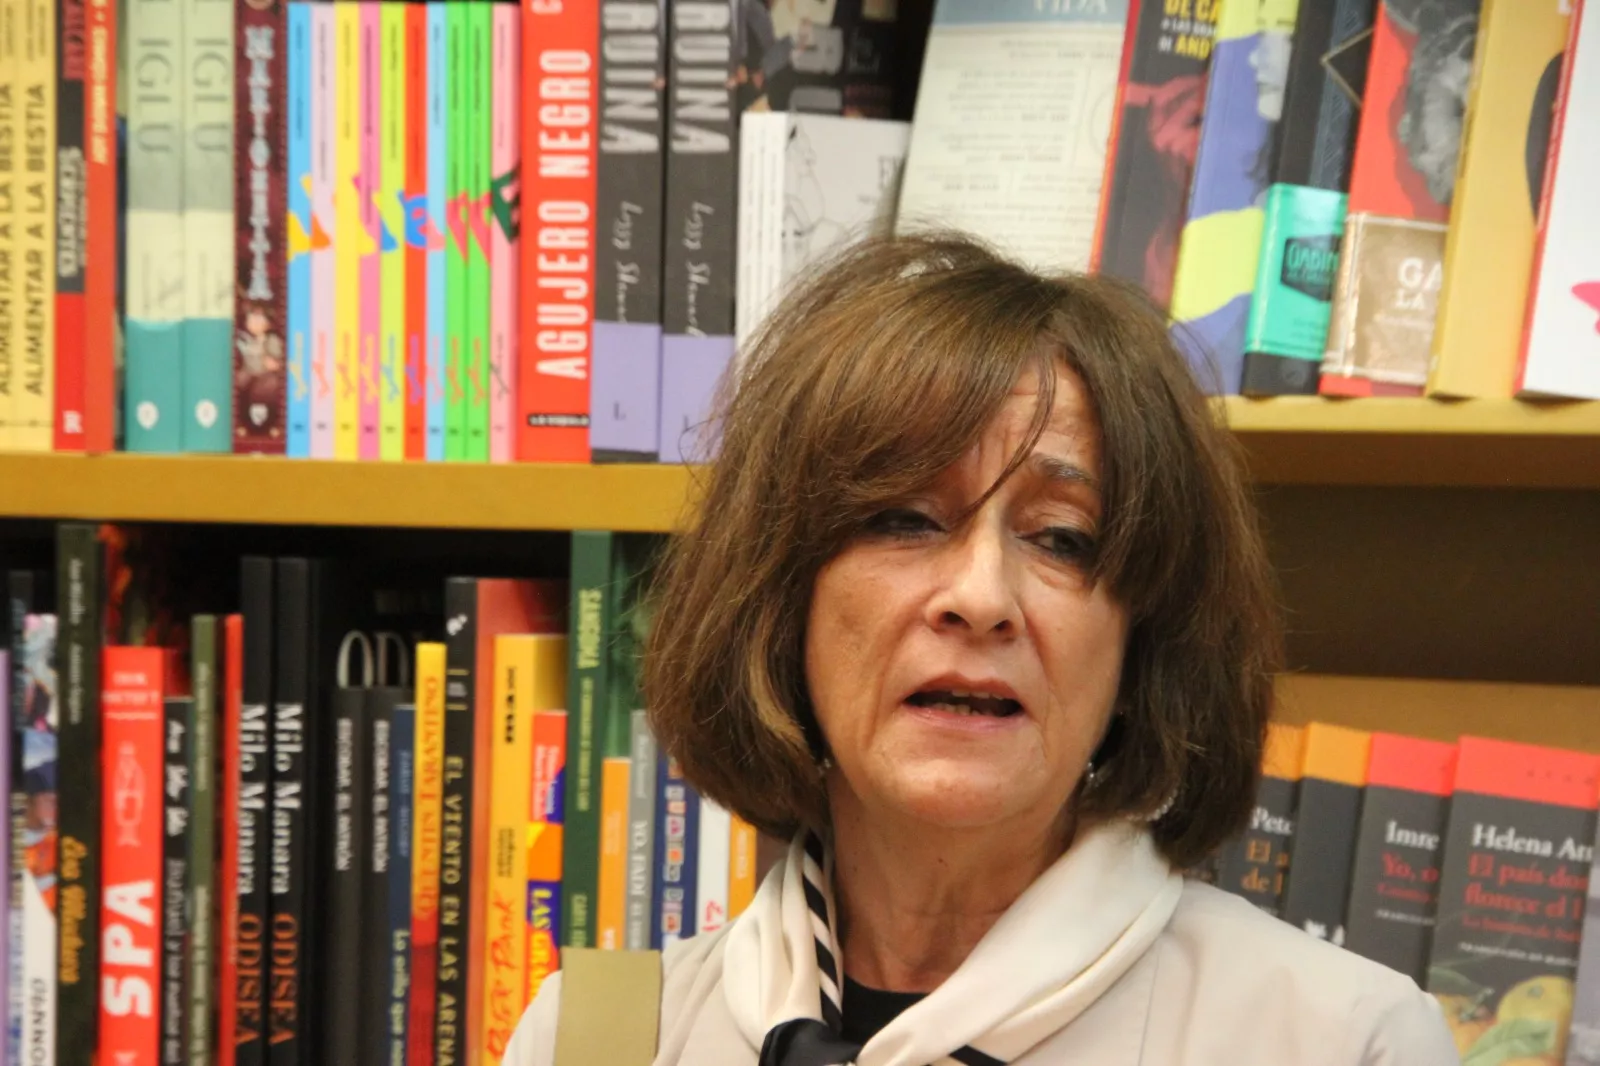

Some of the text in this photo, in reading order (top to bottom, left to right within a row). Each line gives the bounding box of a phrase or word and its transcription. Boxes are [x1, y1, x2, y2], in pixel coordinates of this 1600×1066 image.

[600, 2, 658, 154] RUINA
[672, 2, 730, 154] RUINA
[26, 83, 45, 173] BESTIA
[538, 50, 591, 178] NEGRO
[26, 184, 45, 214] LA
[26, 223, 45, 241] A
[535, 200, 590, 380] AGUJERO
[1394, 288, 1425, 310] LA
[25, 250, 46, 397] ALIMENTAR
[444, 756, 463, 783] EL
[416, 676, 440, 913] QUENTIN TARANTINO
[442, 794, 463, 884] VIENTO
[1246, 839, 1271, 864] El
[1385, 819, 1440, 851] Imre
[1471, 822, 1553, 858] Helena
[236, 703, 267, 1047] Milo Manara ODISEA
[269, 703, 303, 1045] Milo Manara ODISEA
[1240, 867, 1270, 892] de
[1381, 851, 1417, 881] Yo,
[1468, 851, 1495, 877] El
[1498, 860, 1544, 887] país
[440, 895, 460, 925] EN
[531, 888, 552, 929] LAS
[1545, 895, 1567, 919] el
[102, 879, 155, 1017] SPA
[439, 937, 459, 981] LAS
